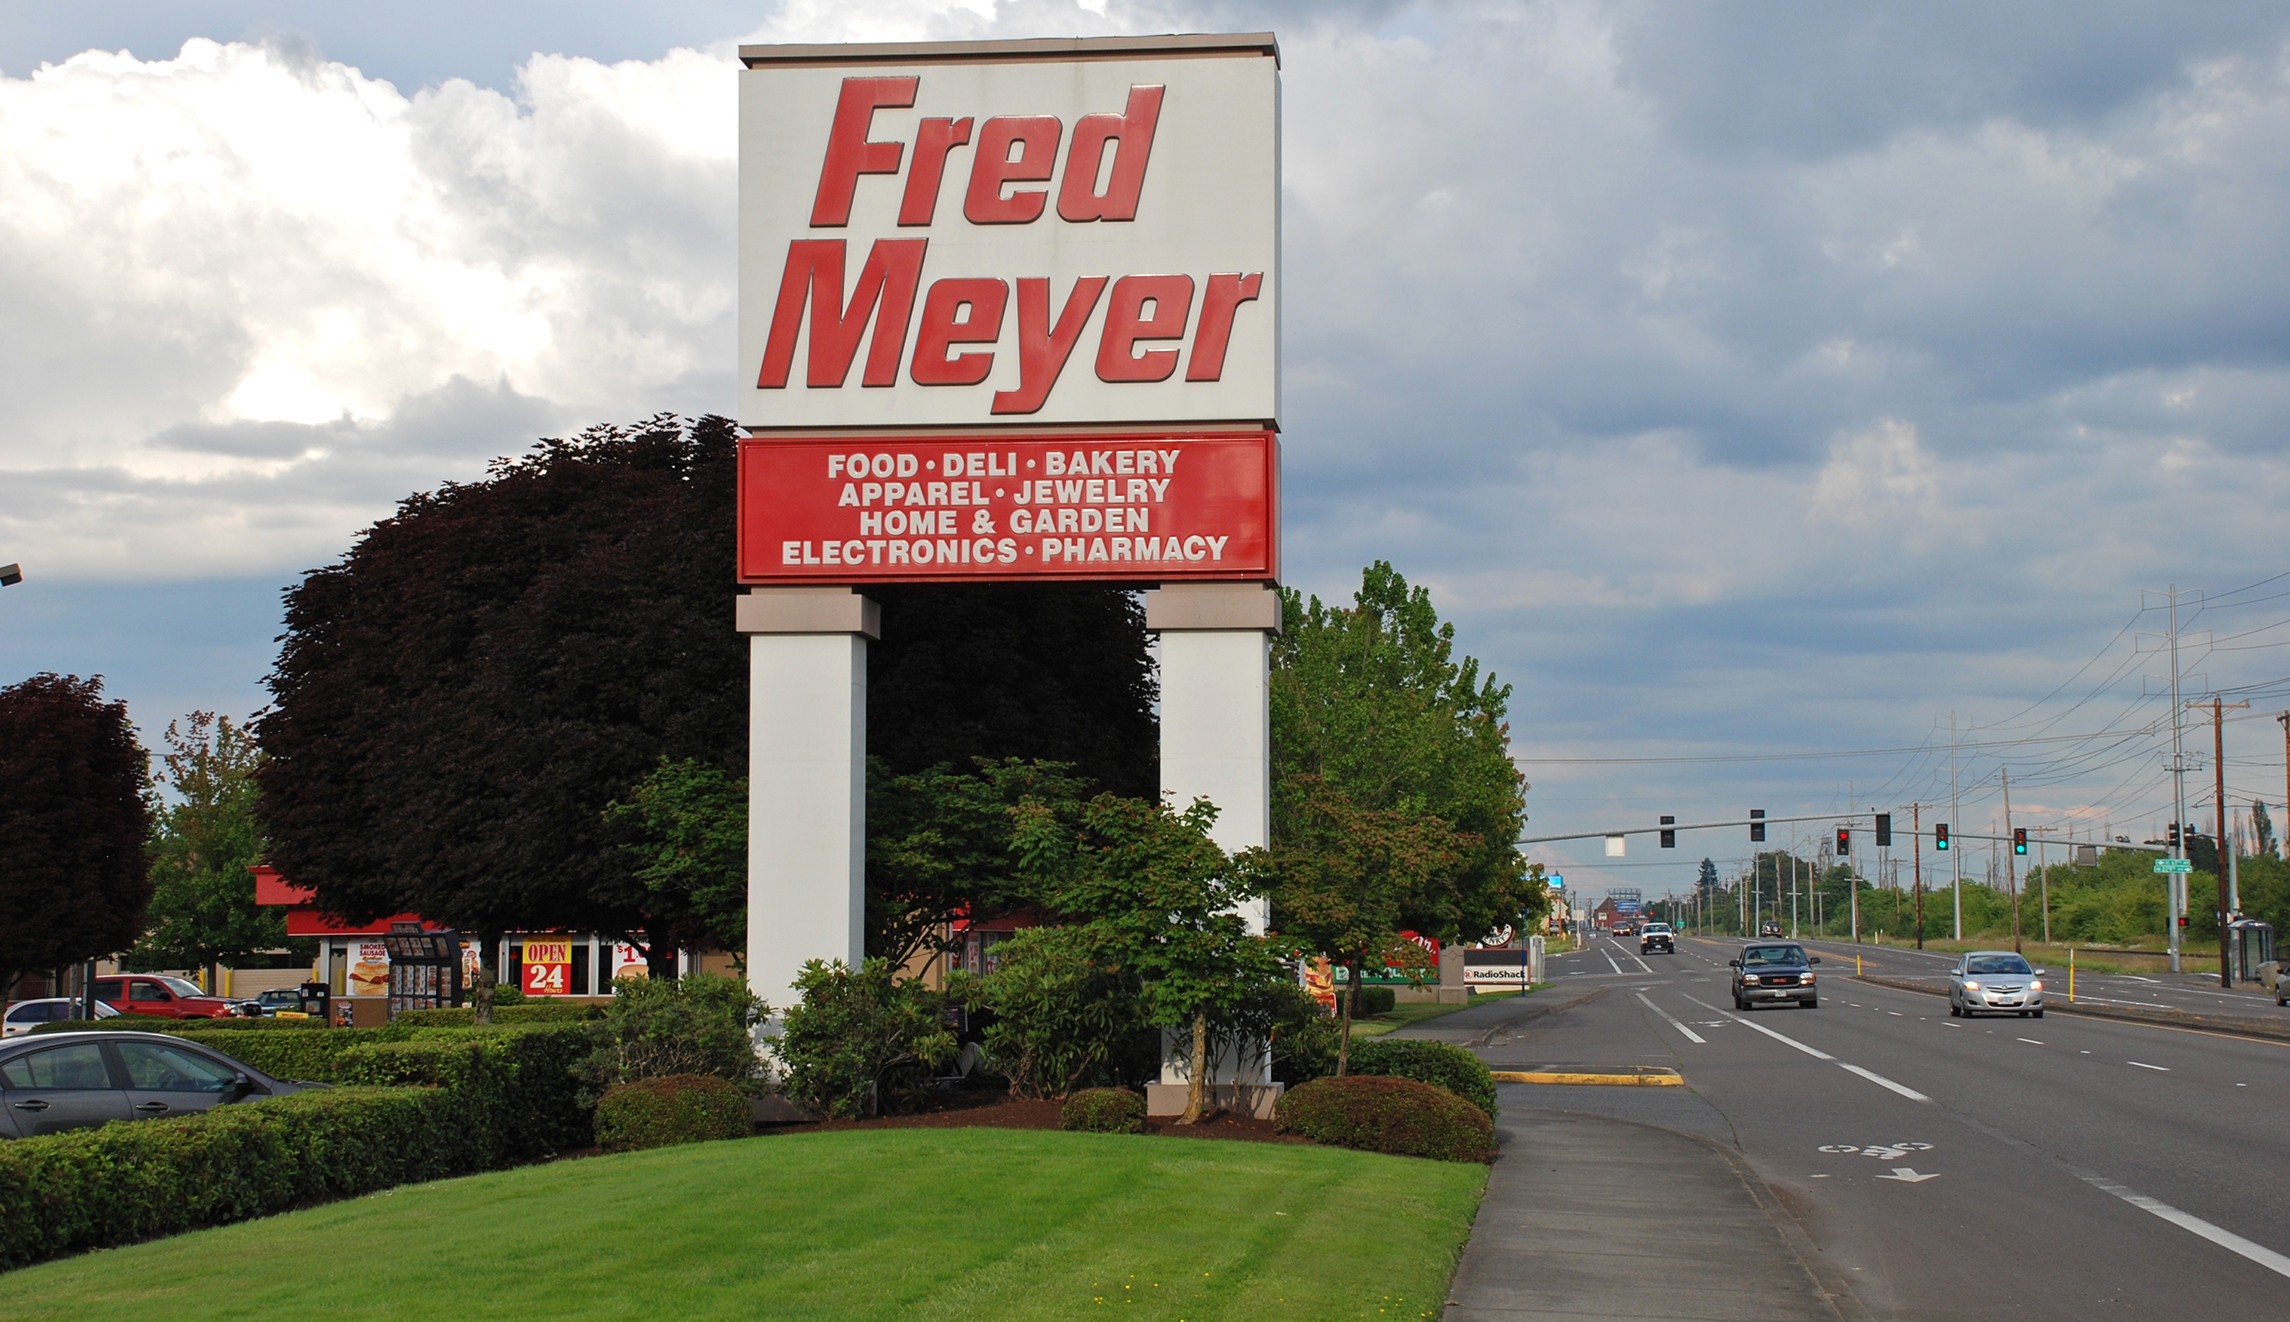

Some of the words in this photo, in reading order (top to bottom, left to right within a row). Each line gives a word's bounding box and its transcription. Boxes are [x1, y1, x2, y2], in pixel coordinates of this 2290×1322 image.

[809, 76, 1165, 227] Fred
[757, 237, 1263, 415] Meyer
[828, 453, 919, 479] FOOD
[943, 452, 1017, 477] DELI
[1045, 449, 1181, 476] BAKERY
[838, 481, 990, 507] APPAREL
[1013, 478, 1171, 505] JEWELRY
[860, 510, 958, 536] HOME
[971, 509, 997, 535] &
[1009, 507, 1149, 534] GARDEN
[782, 538, 1018, 565] ELECTRONICS
[1042, 534, 1229, 562] PHARMACY
[528, 944, 567, 962] OPEN
[530, 964, 564, 989] 24
